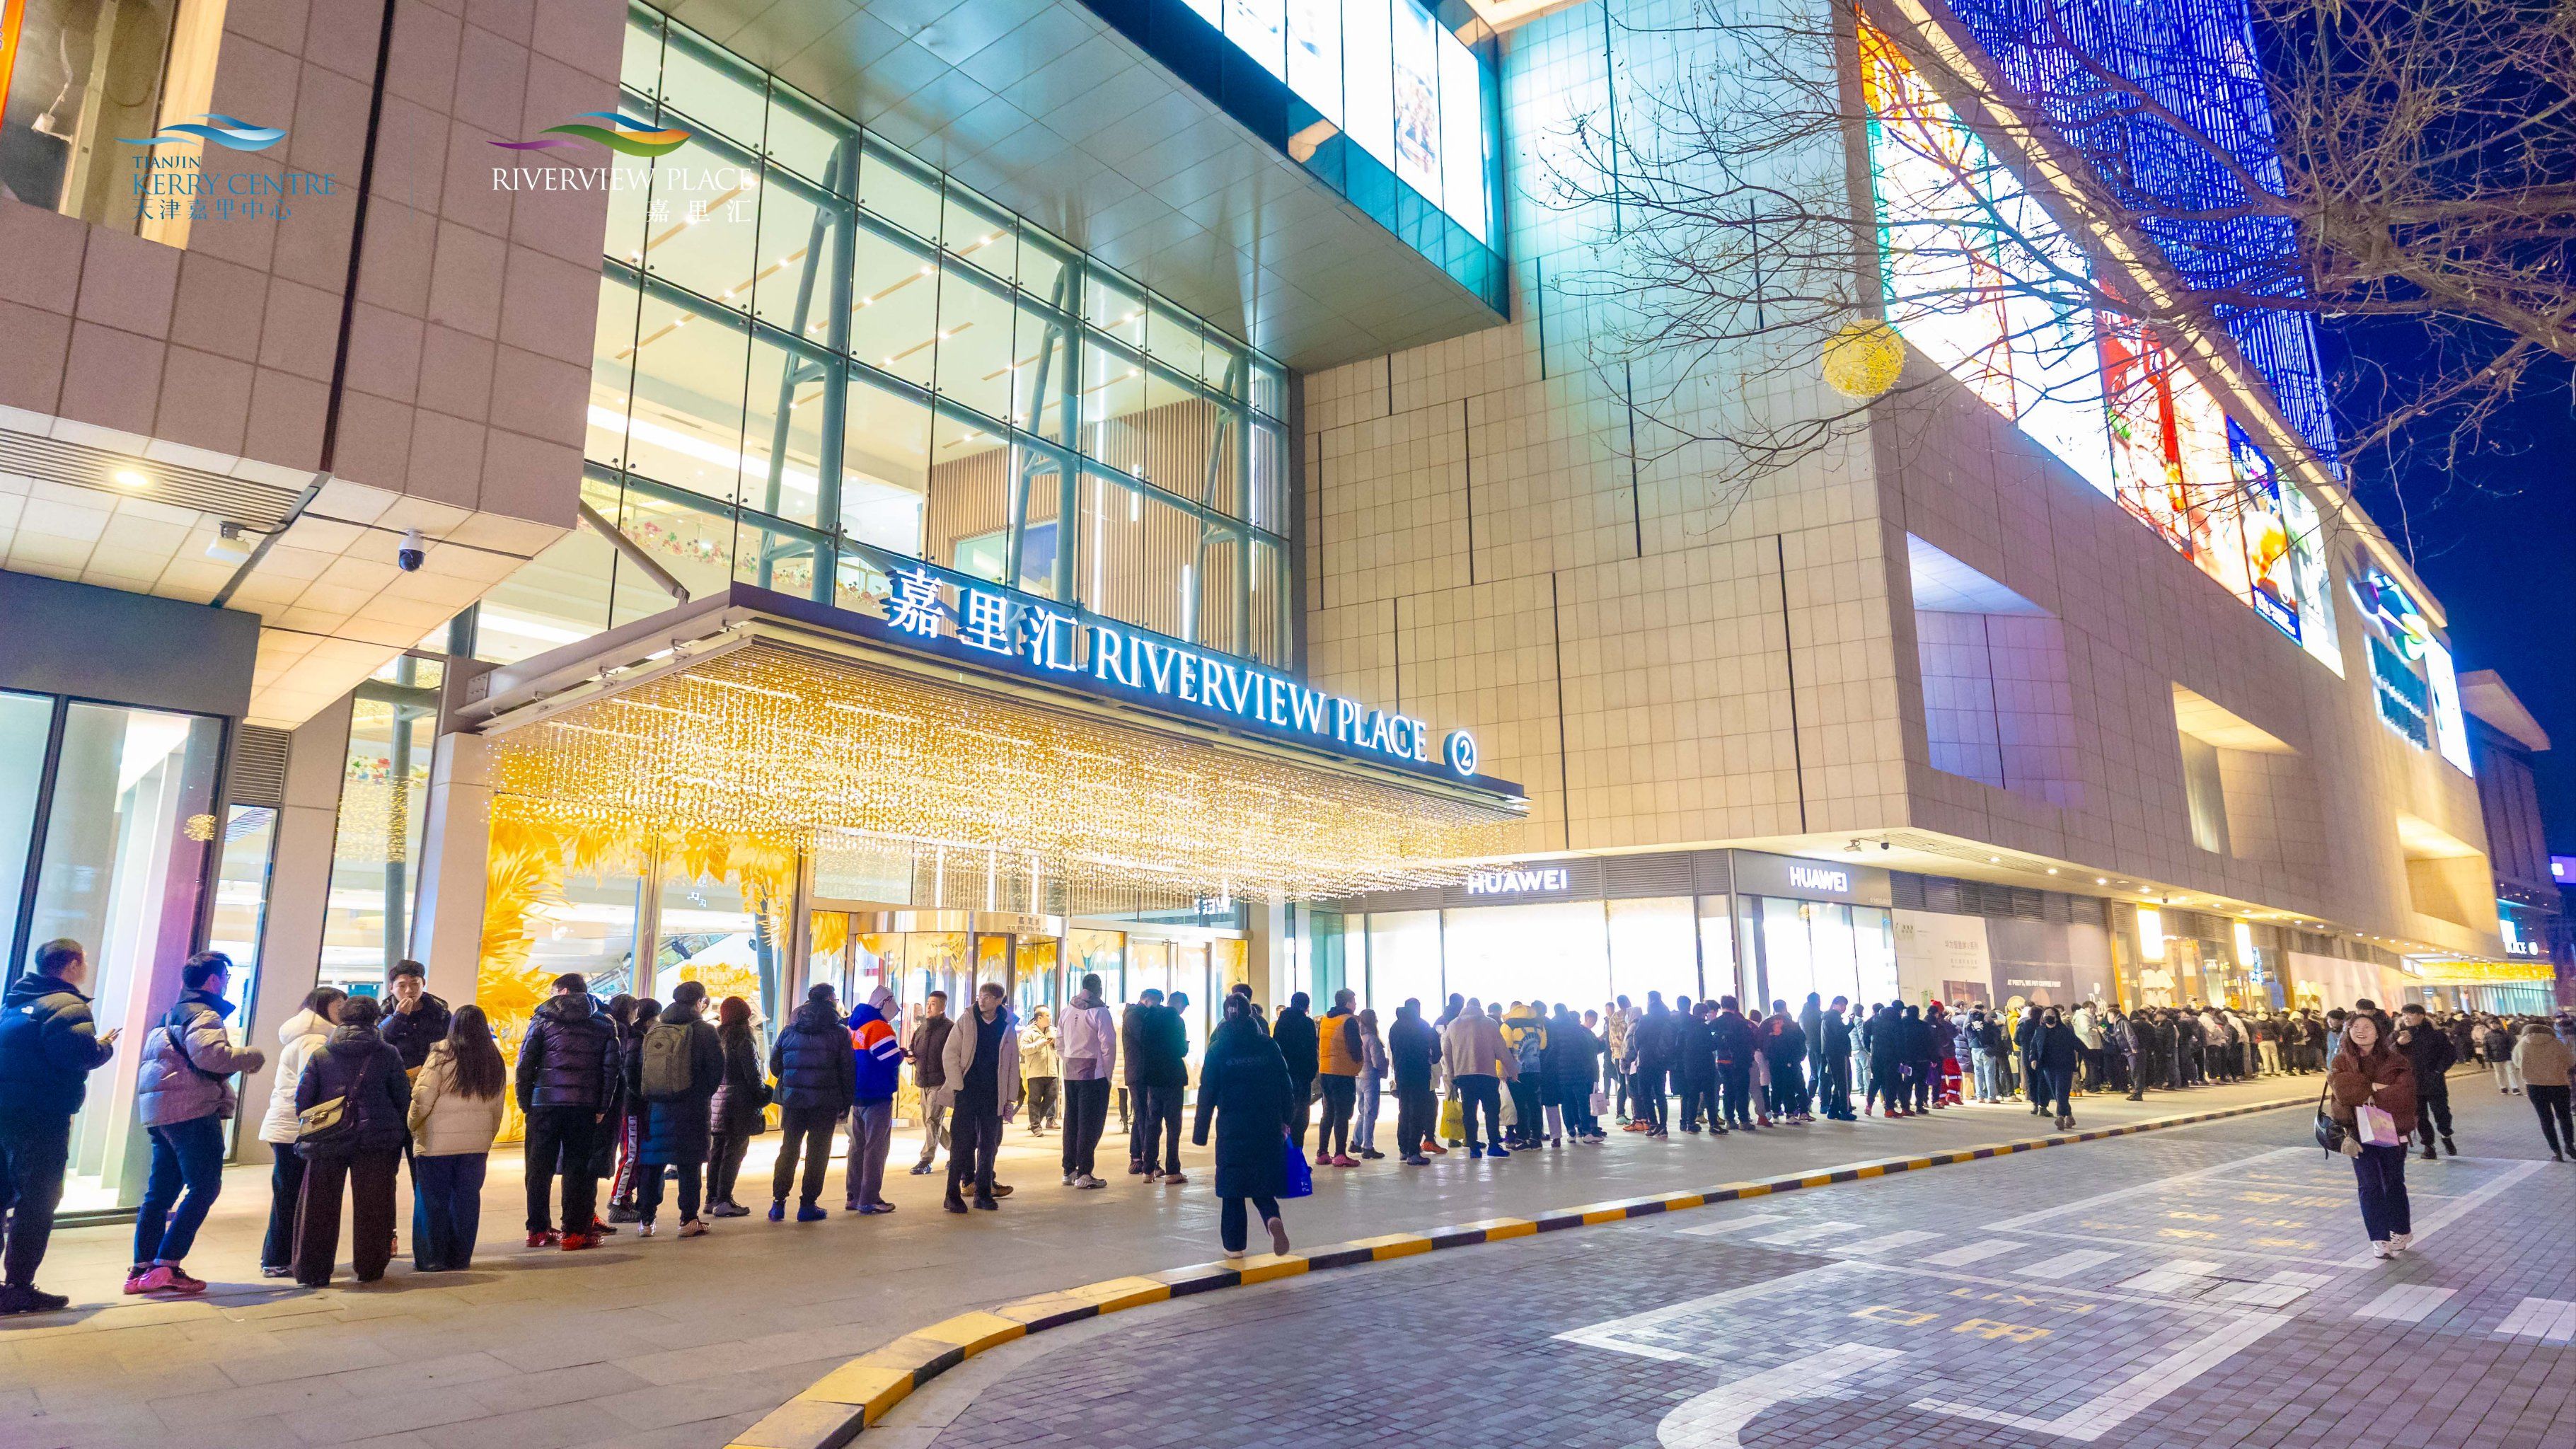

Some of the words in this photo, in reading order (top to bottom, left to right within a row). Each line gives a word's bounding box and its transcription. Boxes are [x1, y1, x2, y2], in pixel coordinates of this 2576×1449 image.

[886, 567, 1080, 671] 嘉里汇
[1094, 626, 1327, 734] RIVERVIEW
[1336, 698, 1428, 763] PLACE
[1467, 869, 1567, 894] HUAWEI
[1789, 865, 1848, 892] HUAWEI
[1847, 1305, 2055, 1344] 出口
